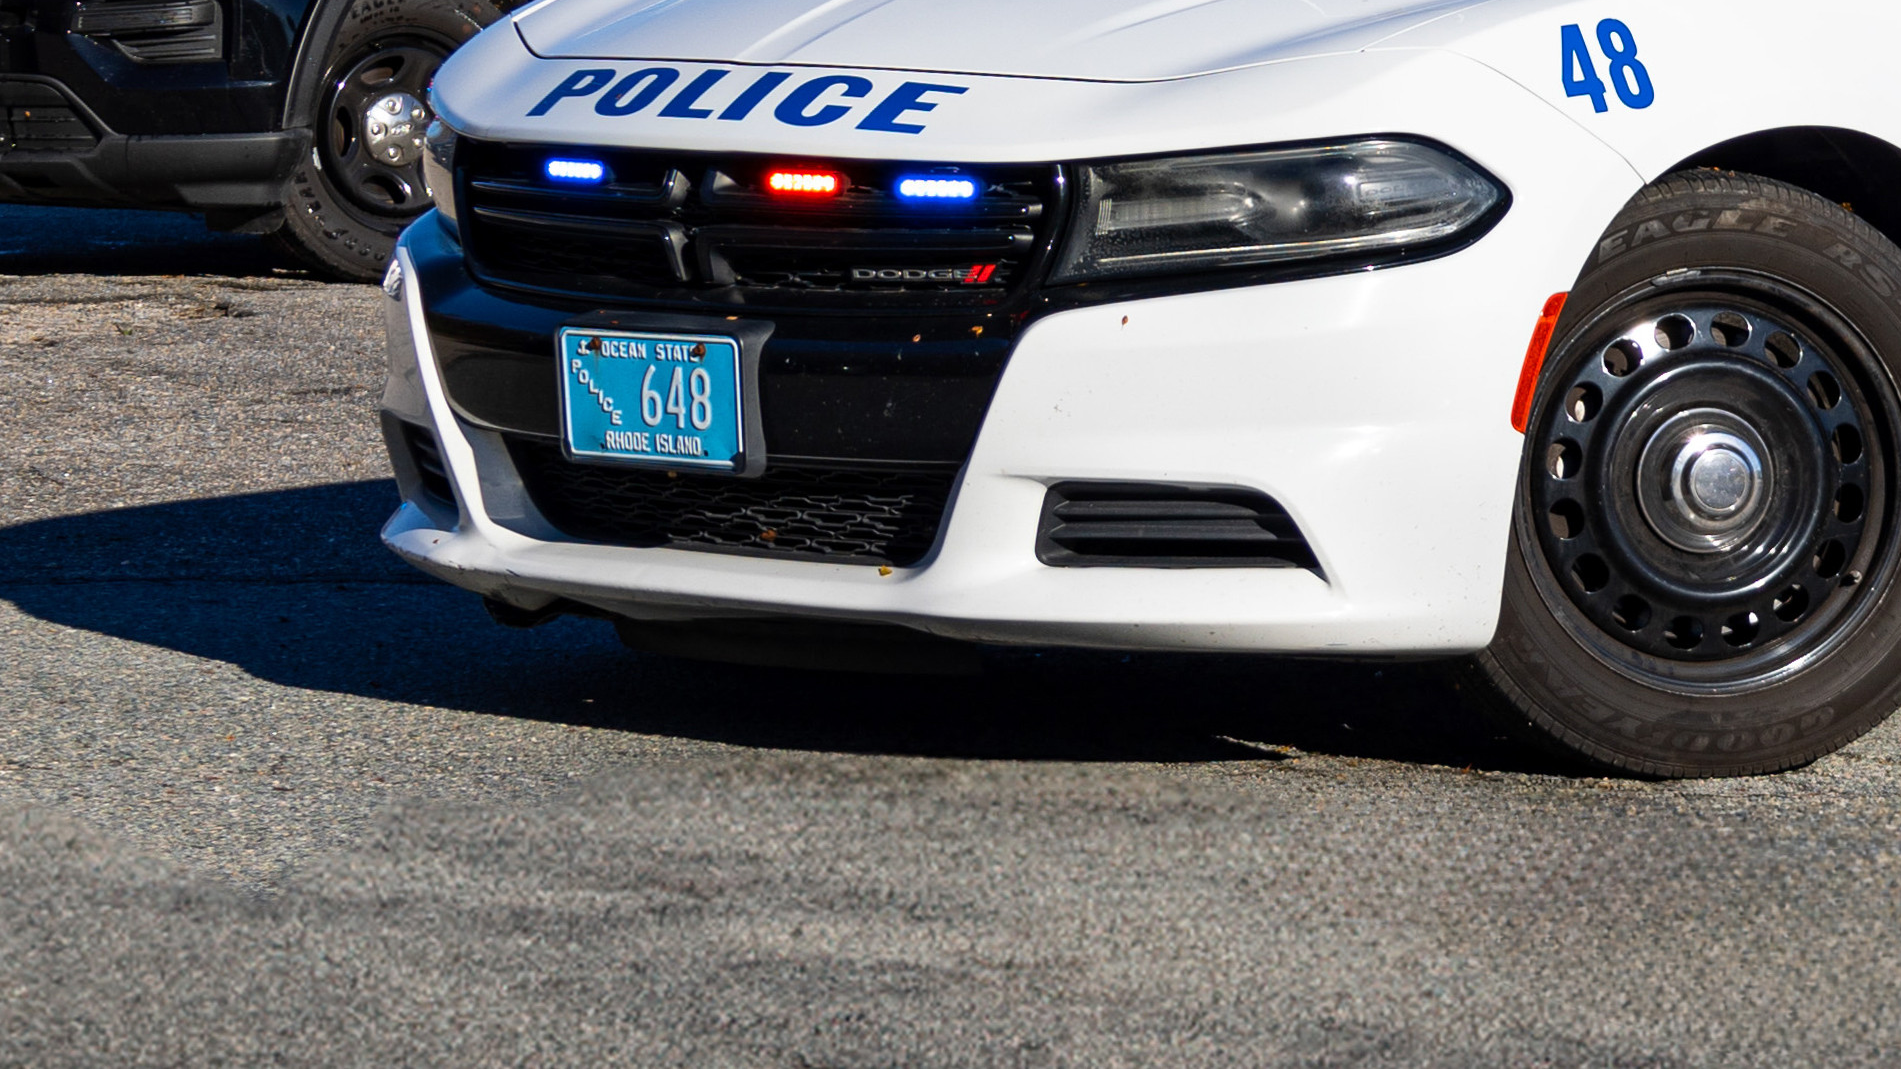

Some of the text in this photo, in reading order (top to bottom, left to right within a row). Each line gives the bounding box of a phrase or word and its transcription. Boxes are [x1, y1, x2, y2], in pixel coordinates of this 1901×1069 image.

[1559, 16, 1656, 114] 48
[526, 67, 969, 134] POLICE
[1597, 209, 1799, 265] EAGLE
[852, 267, 972, 280] DODGE
[601, 341, 648, 360] OCEAN
[571, 358, 623, 426] POLICE
[641, 364, 713, 431] 648
[604, 429, 703, 457] RHODE ISLAND
